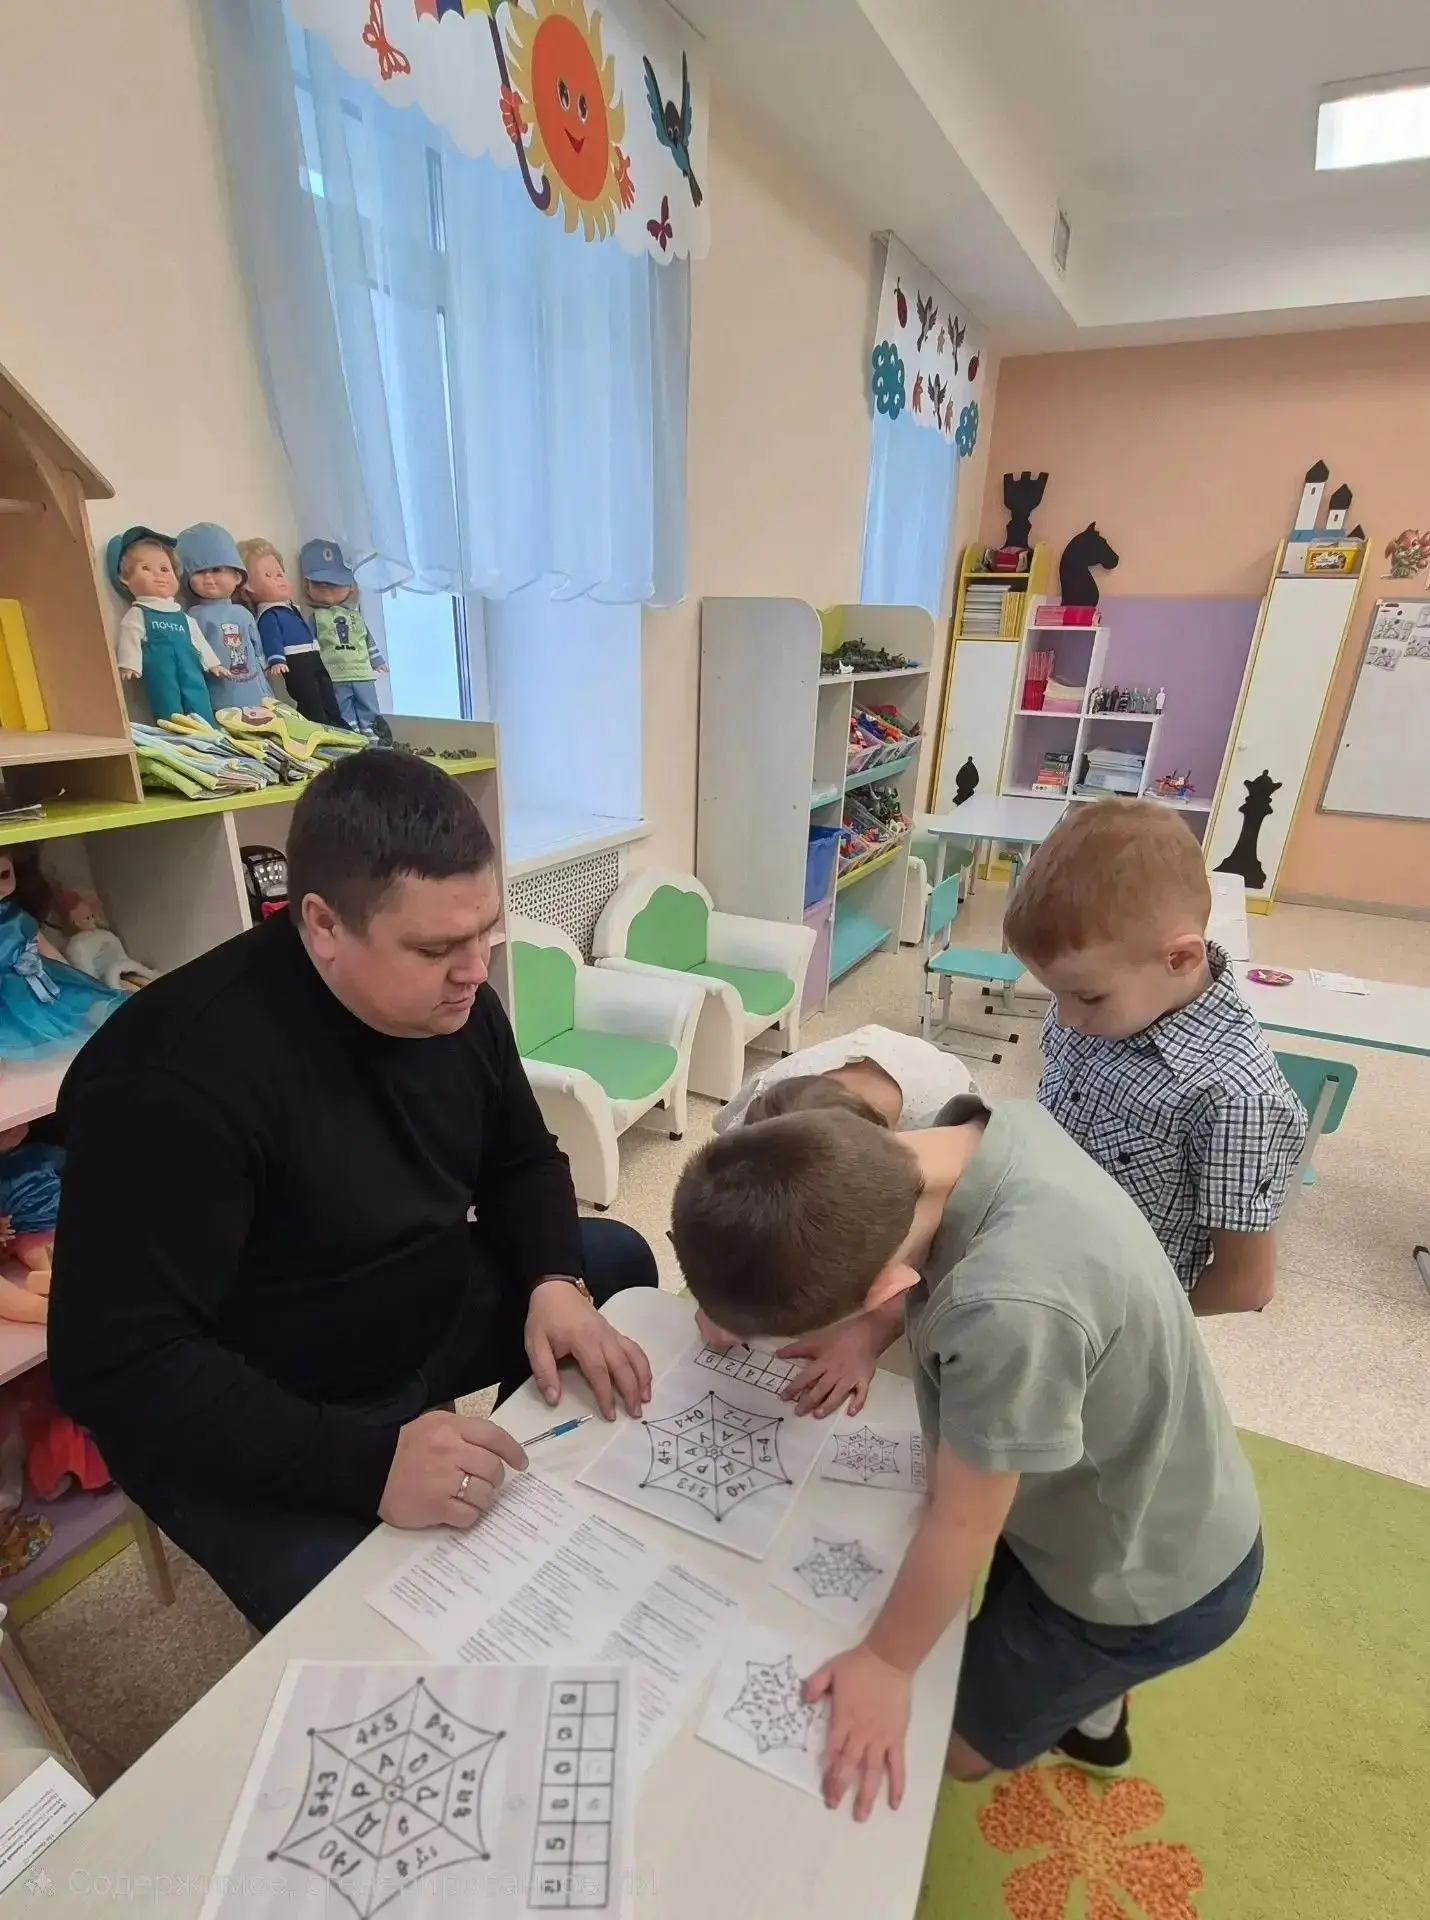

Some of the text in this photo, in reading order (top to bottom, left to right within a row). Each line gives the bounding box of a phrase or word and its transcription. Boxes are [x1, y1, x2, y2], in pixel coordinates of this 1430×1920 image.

[151, 621, 186, 633] ПОЧТА
[725, 1361, 736, 1371] 2
[656, 1440, 672, 1465] 4+5
[676, 1477, 709, 1498] 5+3
